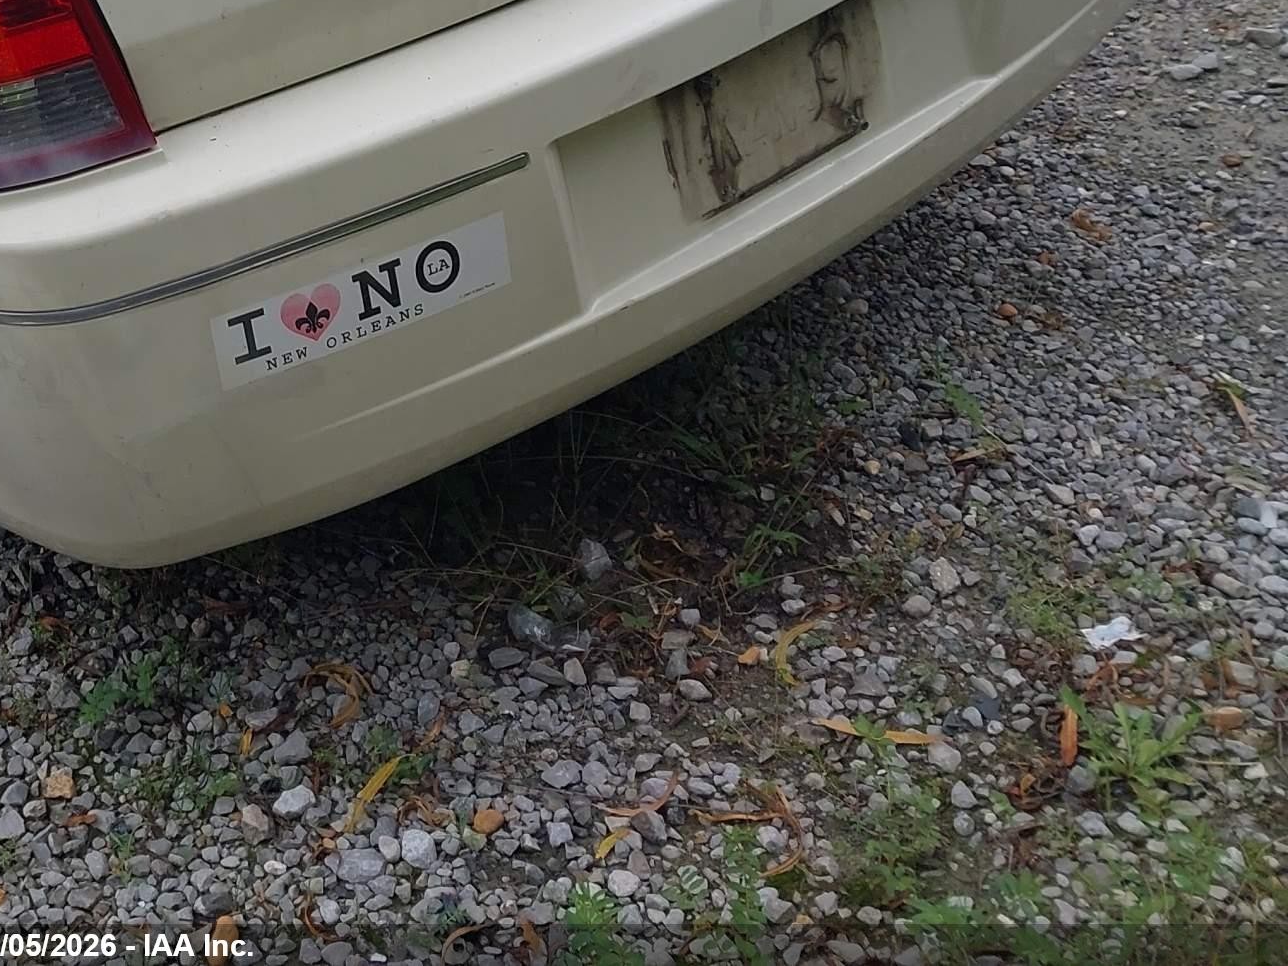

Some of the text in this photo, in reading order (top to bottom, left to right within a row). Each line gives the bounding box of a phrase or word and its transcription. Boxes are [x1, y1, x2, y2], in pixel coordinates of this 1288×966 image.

[426, 258, 451, 277] LA
[227, 307, 272, 366] I
[265, 303, 425, 371] NEW ORLEANS
